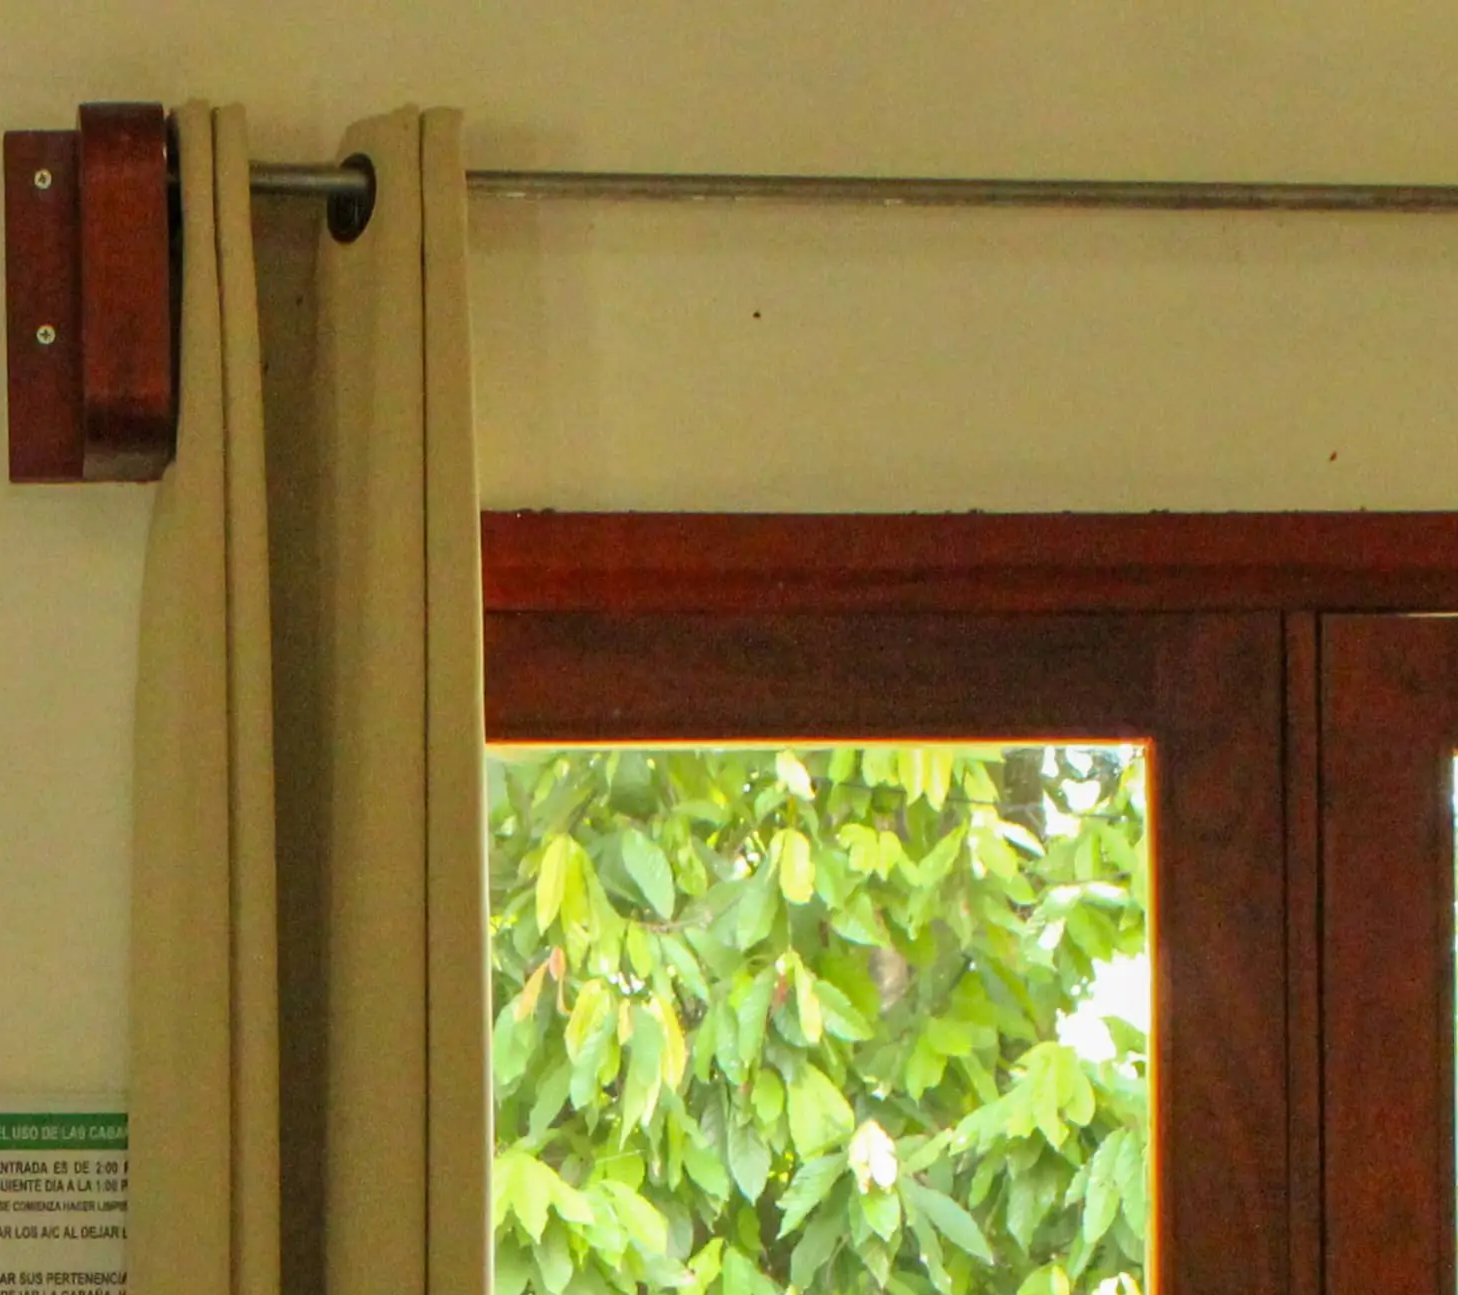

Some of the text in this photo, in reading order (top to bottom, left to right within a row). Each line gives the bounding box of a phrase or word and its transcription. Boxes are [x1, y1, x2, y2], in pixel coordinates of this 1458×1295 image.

[12, 1125, 38, 1140] USO
[41, 1125, 58, 1140] DE
[53, 1161, 68, 1174] ES
[74, 1161, 89, 1174] DE
[66, 1180, 75, 1192] A
[76, 1180, 93, 1192] LA
[15, 1226, 38, 1239] LOS
[40, 1226, 60, 1239] A/C
[63, 1226, 78, 1239] AL
[80, 1226, 119, 1239] DEJAR
[19, 1272, 43, 1285] SUS
